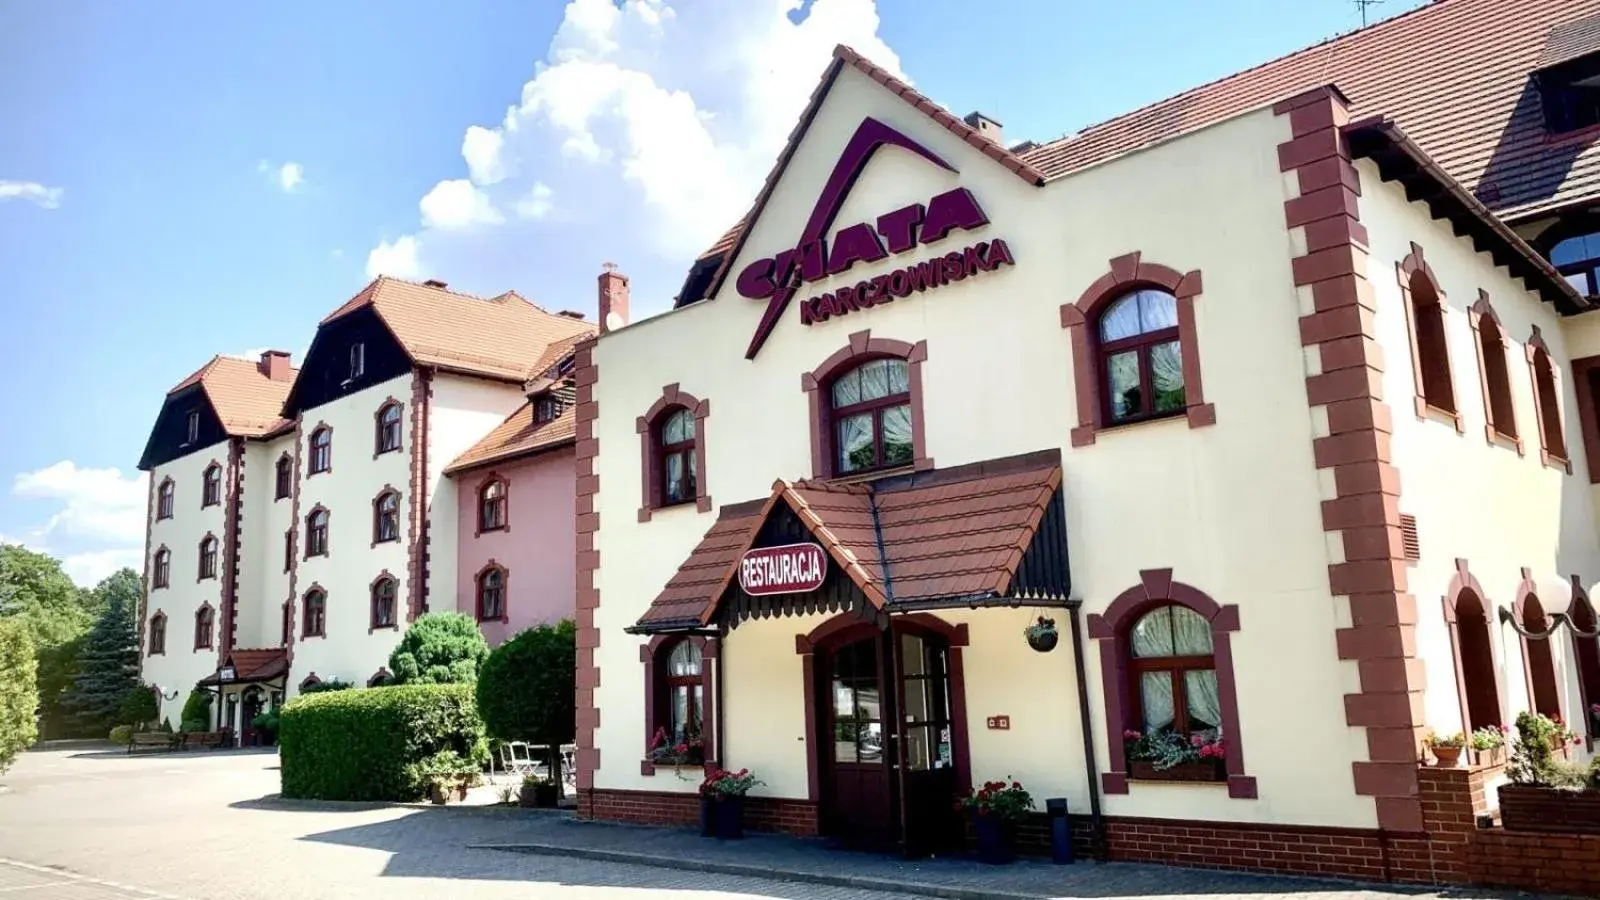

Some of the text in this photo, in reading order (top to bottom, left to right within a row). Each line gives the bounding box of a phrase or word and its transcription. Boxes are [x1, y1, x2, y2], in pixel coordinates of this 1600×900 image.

[736, 187, 990, 299] CHATA
[800, 238, 1015, 325] KARCZOWISKA
[742, 551, 821, 587] RESTAURACJA
